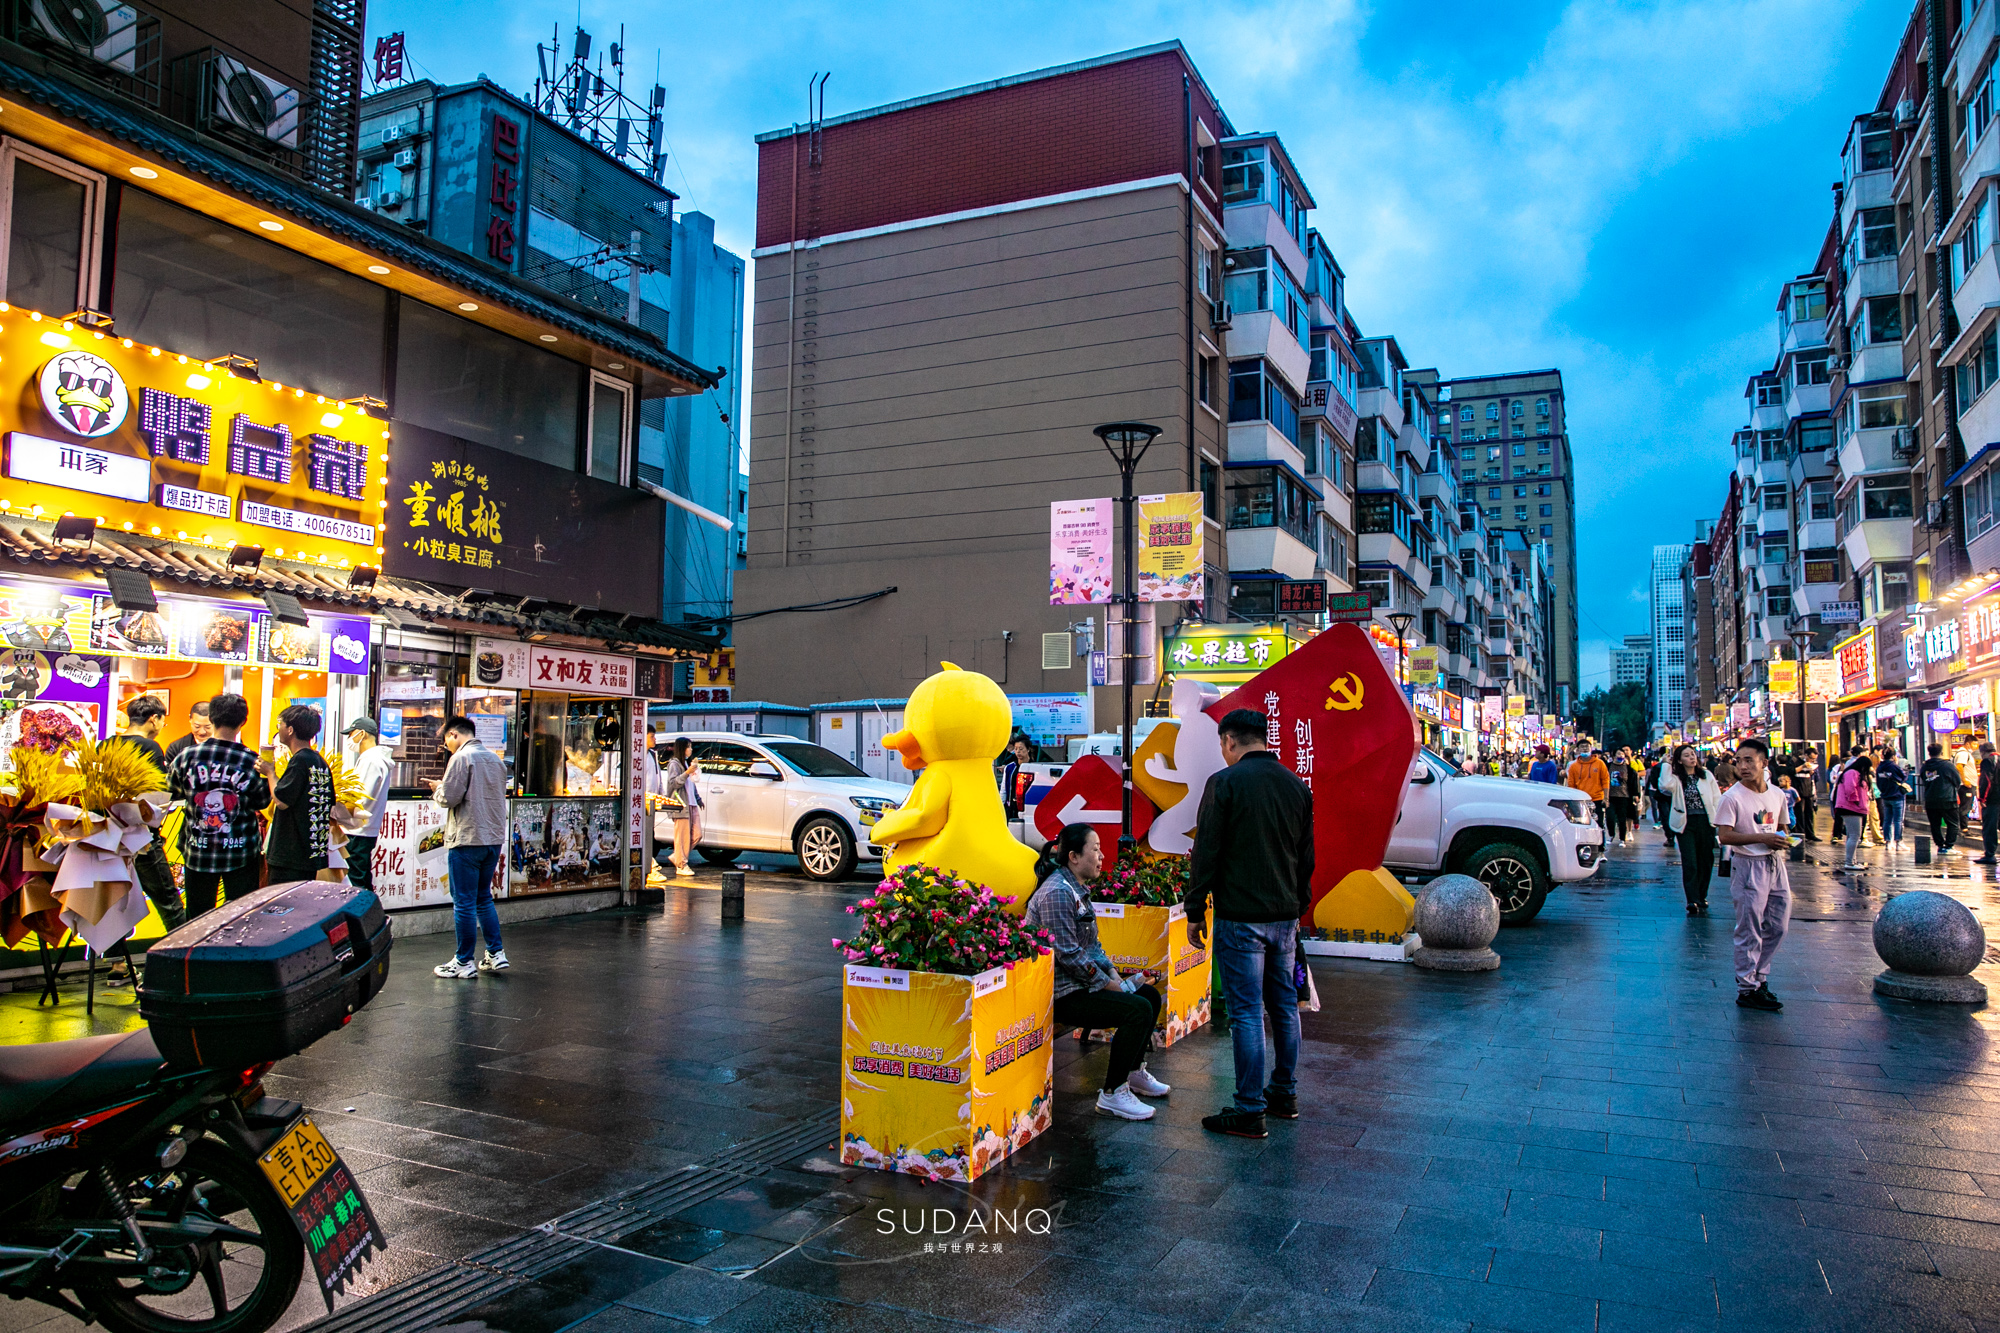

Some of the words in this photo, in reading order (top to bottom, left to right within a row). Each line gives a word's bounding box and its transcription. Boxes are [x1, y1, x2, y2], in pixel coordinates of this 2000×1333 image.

[374, 32, 404, 84] 馆
[487, 114, 519, 264] 巴比伦
[1301, 388, 1326, 407] 出租
[166, 487, 228, 515] 爆品打卡店
[413, 536, 493, 569] 小粒臭豆腐
[1149, 534, 1192, 547] 美好生活
[1174, 637, 1272, 666] 水果超市
[537, 655, 593, 684] 文和友
[600, 663, 627, 675] 臭豆腐
[600, 675, 627, 687] 大香肠
[631, 719, 643, 846] 最好吃的烤冷面
[371, 845, 406, 877] 名吃
[1300, 926, 1404, 945] 服务指导中心
[854, 1056, 904, 1077] 乐享消费
[909, 1062, 961, 1083] 美好生活
[279, 1141, 332, 1202] ET430
[297, 1168, 350, 1232] 五羊本田
[310, 1214, 337, 1253] 川崎
[334, 1189, 361, 1226] 春风
